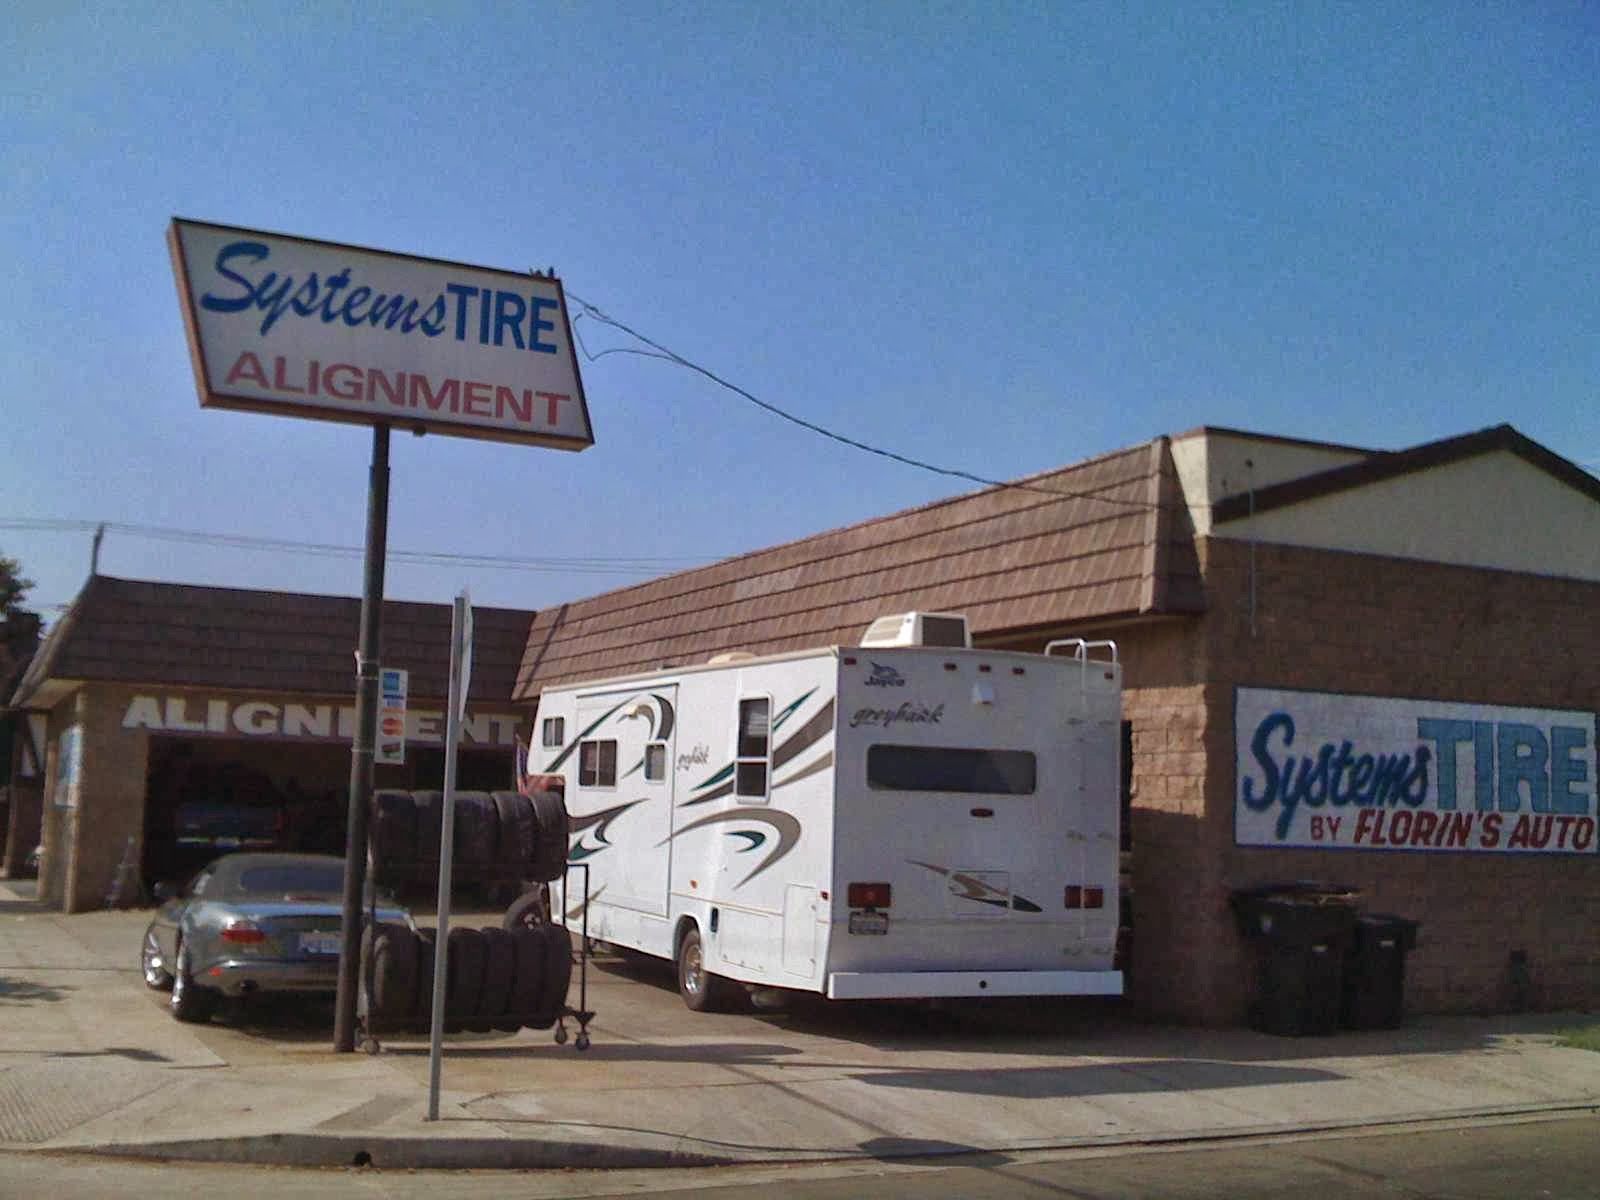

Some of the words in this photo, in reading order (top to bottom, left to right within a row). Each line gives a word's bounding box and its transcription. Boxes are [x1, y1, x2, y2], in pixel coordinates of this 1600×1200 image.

[201, 241, 447, 337] Systems
[446, 282, 559, 354] TIRE
[224, 350, 571, 427] ALIGNMENT
[1242, 707, 1432, 840] Systems
[1416, 716, 1591, 815] TIRE
[1310, 815, 1342, 840] BY
[1353, 808, 1504, 848] FLORIN'S
[1507, 814, 1595, 851] AUTO
